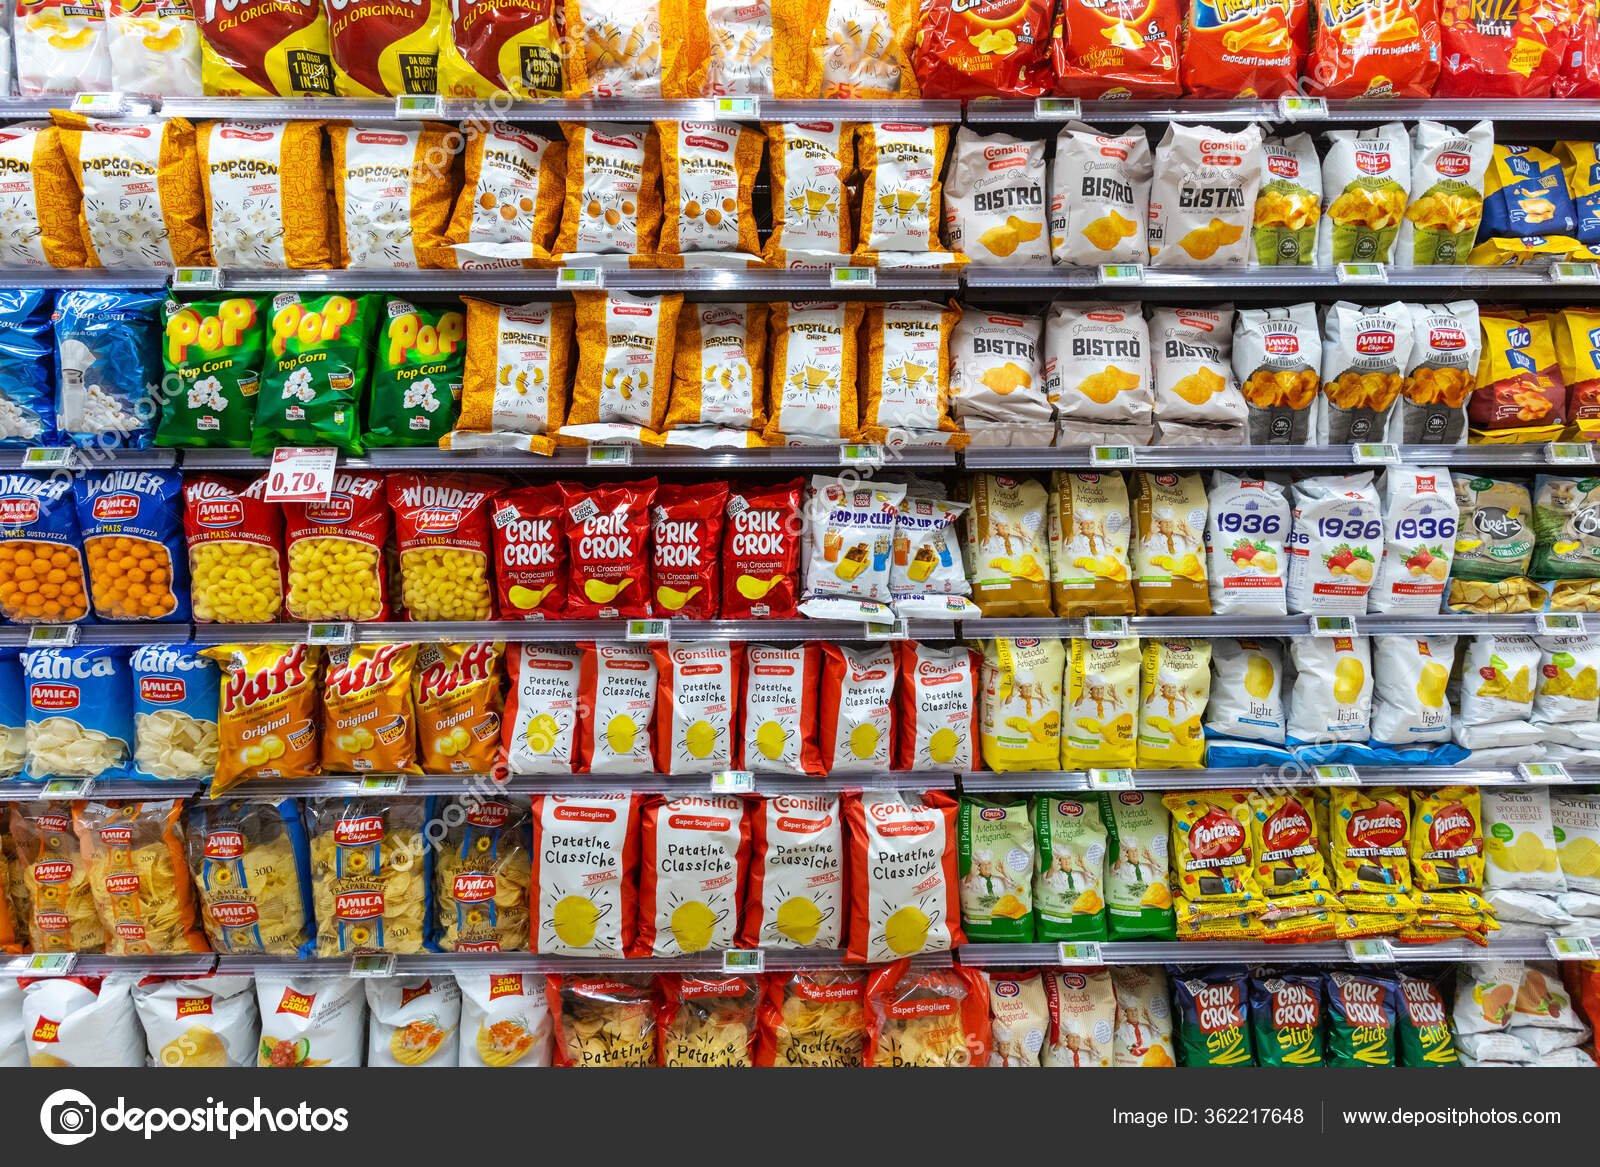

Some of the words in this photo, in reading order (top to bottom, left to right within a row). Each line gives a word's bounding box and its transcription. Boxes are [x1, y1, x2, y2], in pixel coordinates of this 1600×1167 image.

[219, 16, 238, 32] GLI
[240, 2, 302, 23] ORIGINALI
[1022, 22, 1031, 35] 6
[297, 53, 306, 61] DA
[533, 59, 558, 73] BUSTA
[878, 143, 933, 156] TORTILLA
[210, 160, 278, 175] POPCORN
[974, 182, 1041, 211] BISTRÒ
[1082, 177, 1133, 204] BISTRÒ
[1180, 183, 1244, 207] BISTRÒ
[886, 322, 938, 332] TORTILLA
[1265, 337, 1296, 347] AMICA
[1361, 333, 1393, 345] AMICA
[1508, 328, 1529, 348] TUC
[974, 337, 1035, 361] BISTRÒ
[1073, 337, 1140, 358] BISTRÒ
[279, 356, 296, 371] Pop
[297, 351, 327, 364] Corn
[179, 368, 201, 380] Pop
[203, 359, 233, 373] Corn
[396, 367, 417, 381] Pop
[419, 363, 447, 375] Corn
[87, 471, 166, 497] WONDER
[405, 486, 484, 506] WONDER
[96, 499, 137, 510] AMICA
[199, 504, 240, 515] AMICA
[584, 513, 629, 535] CRIK
[735, 511, 780, 531] CRIK
[1218, 512, 1280, 534] 1936
[1396, 517, 1455, 539] 1936
[506, 521, 551, 541] CRIK
[657, 522, 698, 543] CRIK
[1318, 517, 1381, 540] 1936
[210, 530, 229, 540] MAIS
[240, 532, 271, 542] FORMAGGIO
[579, 536, 632, 560] CROK
[733, 532, 784, 556] CROK
[504, 544, 555, 566] CROK
[749, 561, 782, 569] Croccanti
[673, 648, 726, 662] Consilia
[224, 644, 309, 714] Puff
[418, 643, 495, 704] Puff
[142, 681, 182, 692] AMICA
[530, 676, 569, 687] Patatine
[608, 676, 647, 687] Patatine
[683, 682, 722, 693] Patatine
[755, 683, 793, 693] Patatine
[33, 687, 76, 700] AMICA
[524, 686, 572, 699] Classiche
[603, 686, 650, 699] Classiche
[849, 686, 885, 695] Patatine
[925, 691, 962, 701] Patatine
[679, 692, 726, 704] Classiche
[751, 692, 796, 704] Classiche
[846, 695, 890, 706] Classiche
[922, 700, 968, 711] Classiche
[1250, 701, 1272, 718] light
[336, 708, 378, 729] Original
[435, 706, 474, 731] Original
[1337, 709, 1358, 723] light
[1422, 711, 1443, 725] light
[242, 713, 290, 740] Original
[666, 796, 738, 810] Consilia
[1063, 805, 1080, 813] PATA
[1496, 805, 1543, 814] SFOGLIETTE
[560, 810, 581, 818] Saper
[583, 811, 610, 820] Scegliere
[1120, 810, 1147, 820] Metodo
[336, 821, 381, 834] AMICA
[675, 818, 694, 827] Saper
[696, 819, 724, 828] Scegliere
[1353, 814, 1402, 837] Fonzies
[1435, 814, 1470, 841] Fonzies
[208, 836, 241, 848] AMICA
[348, 832, 369, 840] Chips
[552, 835, 610, 850] Patatine
[669, 844, 724, 856] Patatine
[777, 845, 833, 857] Patatine
[879, 849, 935, 864] Patatine
[545, 850, 616, 868] Classiche
[661, 858, 731, 872] Classiche
[770, 853, 838, 869] Classiche
[35, 864, 71, 875] AMICA
[107, 875, 139, 887] AMICA
[455, 878, 493, 890] AMICA
[338, 896, 382, 908] AMICA
[213, 906, 256, 917] AMICA
[350, 907, 370, 915] Chips
[38, 915, 68, 926] AMICA
[493, 984, 521, 994] CARLO
[497, 978, 515, 986] SAN
[1064, 993, 1090, 1002] Metodo
[1200, 987, 1233, 1006] CRIK
[1278, 983, 1311, 1006] CRIK
[1343, 983, 1378, 1003] CRIK
[180, 1003, 209, 1014] CARLO
[281, 999, 310, 1013] CARLO
[893, 1004, 918, 1014] Saper
[920, 1002, 950, 1012] Scegliere
[1200, 1006, 1239, 1028] CROK
[1275, 1005, 1315, 1026] CROK
[1345, 1004, 1385, 1025] CROK
[1409, 1002, 1444, 1025] CROK
[1206, 1025, 1242, 1054] Stick
[1277, 1026, 1313, 1049] Stick
[1353, 1026, 1387, 1049] Stick
[1419, 1024, 1450, 1049] Stick
